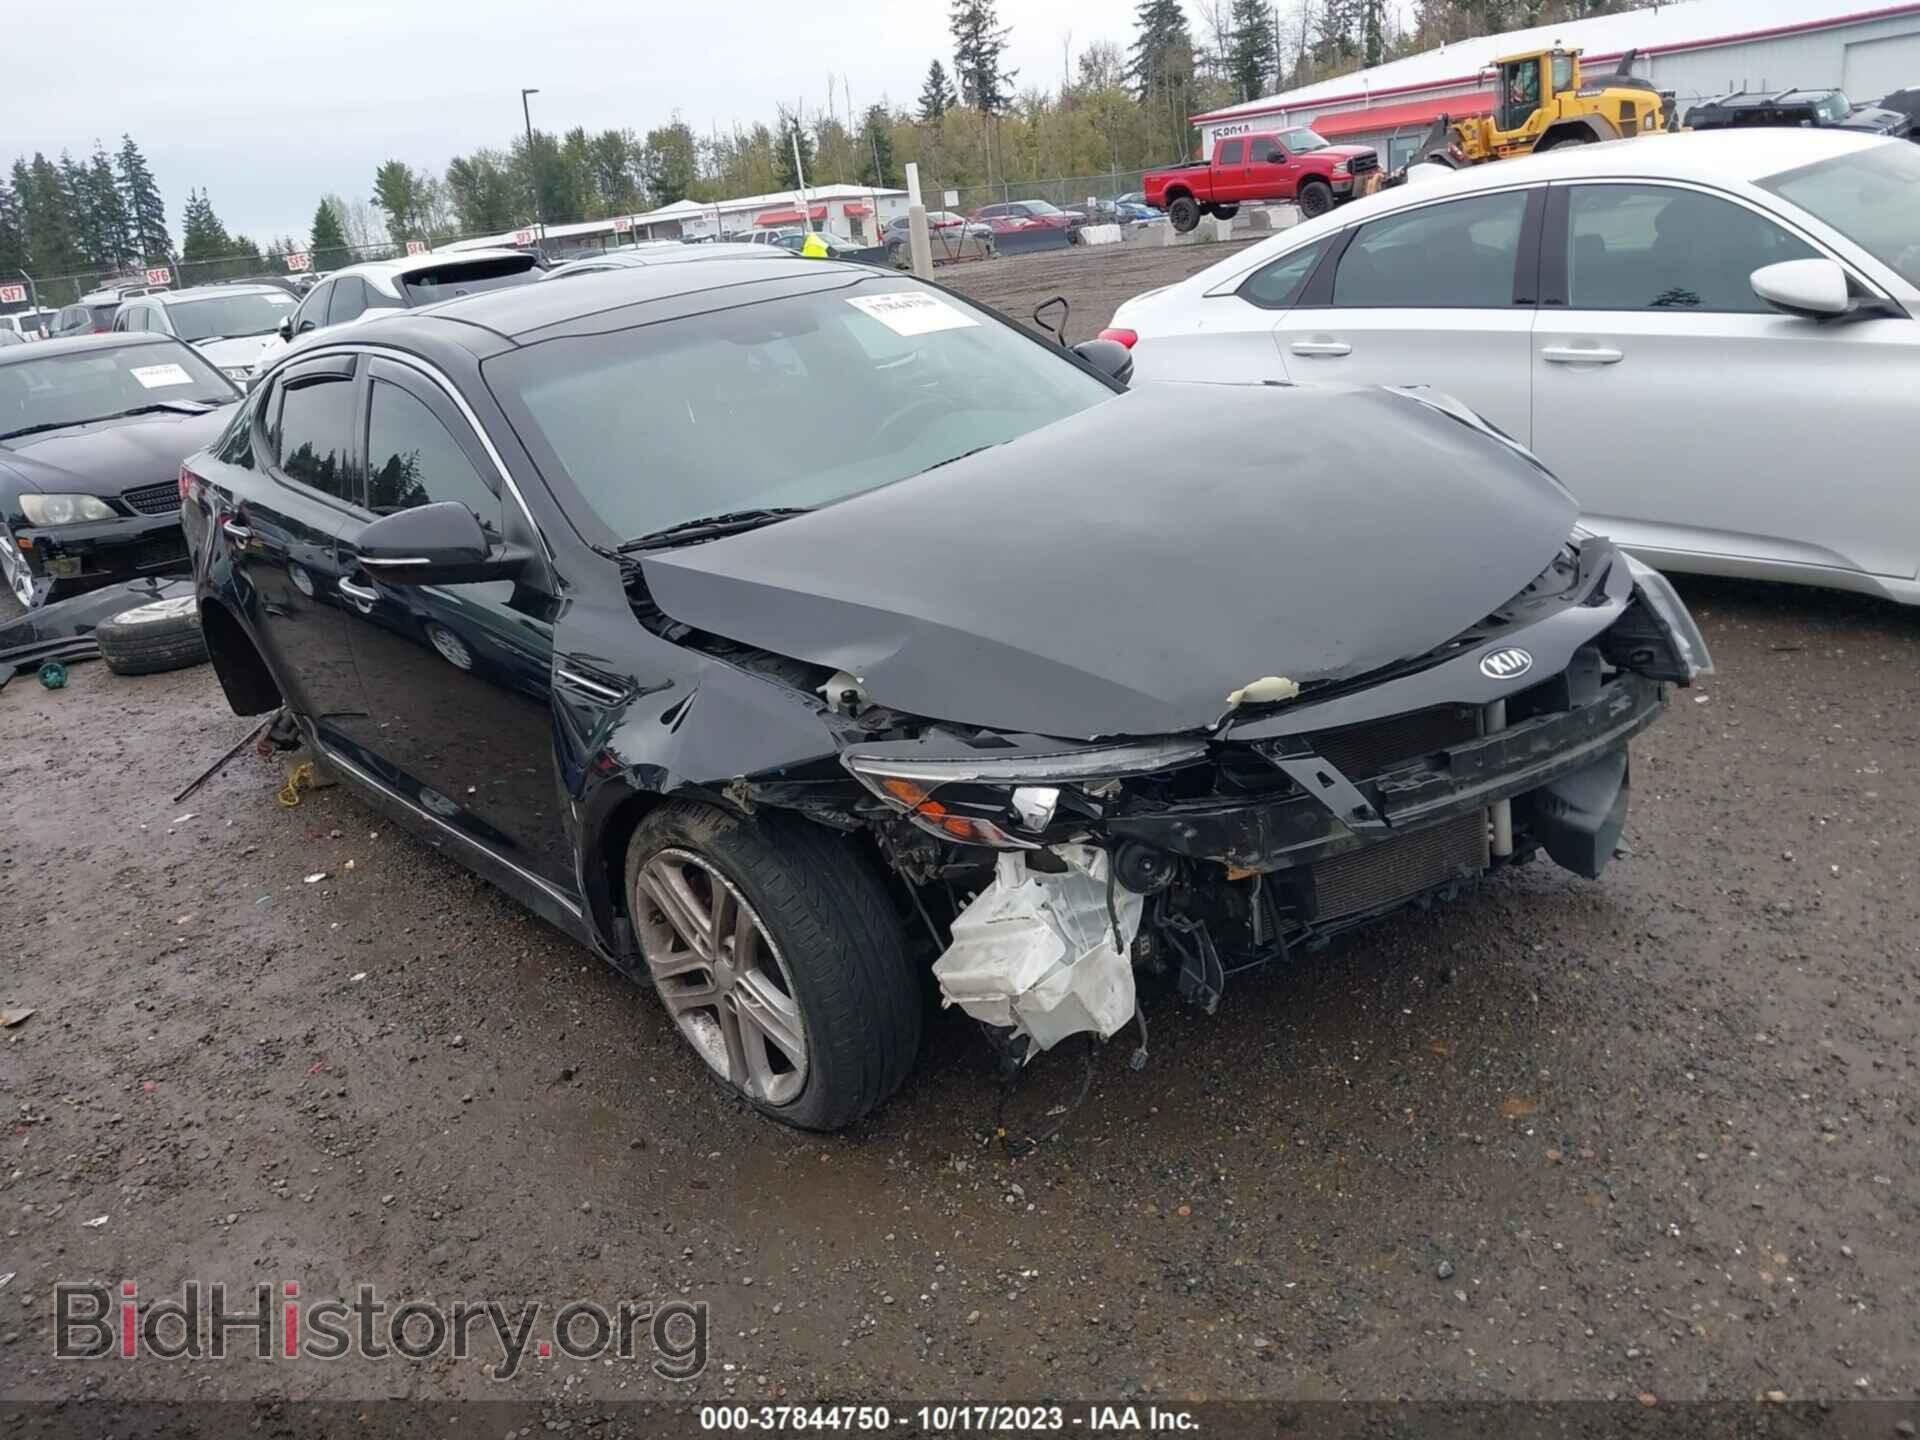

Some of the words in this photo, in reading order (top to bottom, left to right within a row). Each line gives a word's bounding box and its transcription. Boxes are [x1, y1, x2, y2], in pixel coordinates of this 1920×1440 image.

[149, 270, 169, 283] SF6
[2, 287, 22, 301] SF7
[1486, 650, 1528, 674] KIA
